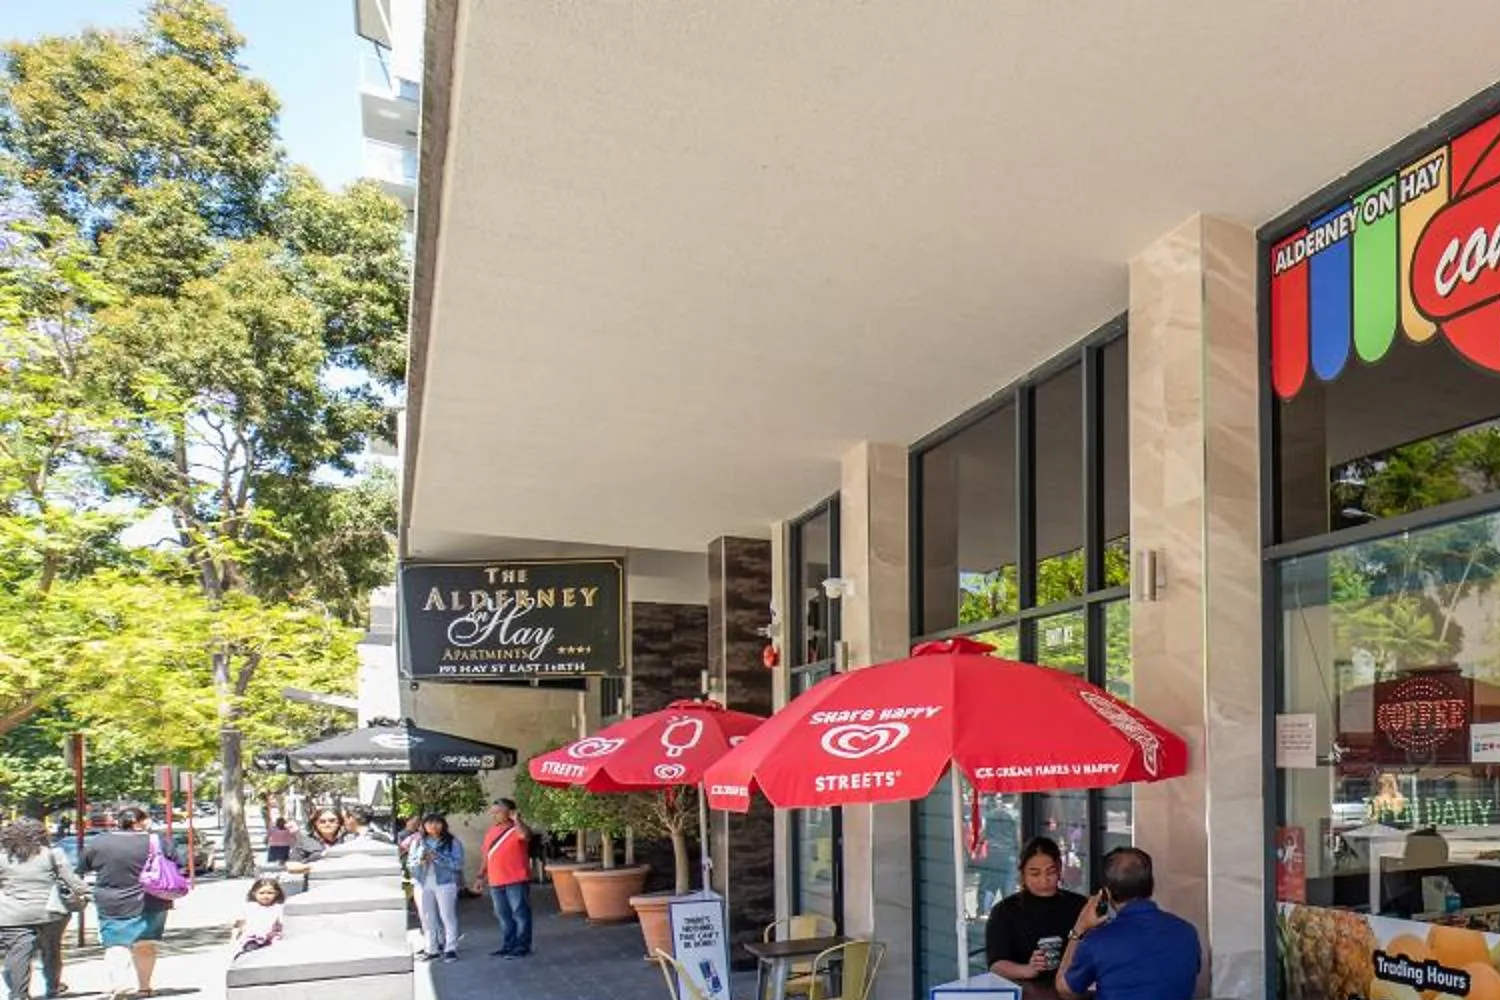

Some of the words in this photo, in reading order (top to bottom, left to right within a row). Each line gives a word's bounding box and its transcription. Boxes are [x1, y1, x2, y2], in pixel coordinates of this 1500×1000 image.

[1273, 209, 1360, 275] ALDERNEY
[1363, 186, 1396, 224] ON
[1400, 156, 1444, 206] HAY
[483, 567, 529, 585] THE
[422, 587, 600, 611] ALDERNEY
[447, 597, 555, 660] Hay
[441, 647, 532, 662] APARTMENTS
[460, 664, 489, 673] HAY
[490, 663, 507, 673] ST
[509, 662, 540, 673] EAST
[539, 759, 586, 777] STREETS
[995, 765, 1033, 779] CREAM
[1083, 763, 1120, 775] HAPPY
[814, 770, 897, 792] STREETS
[1377, 955, 1423, 986] Trading
[1426, 967, 1467, 989] Hours
